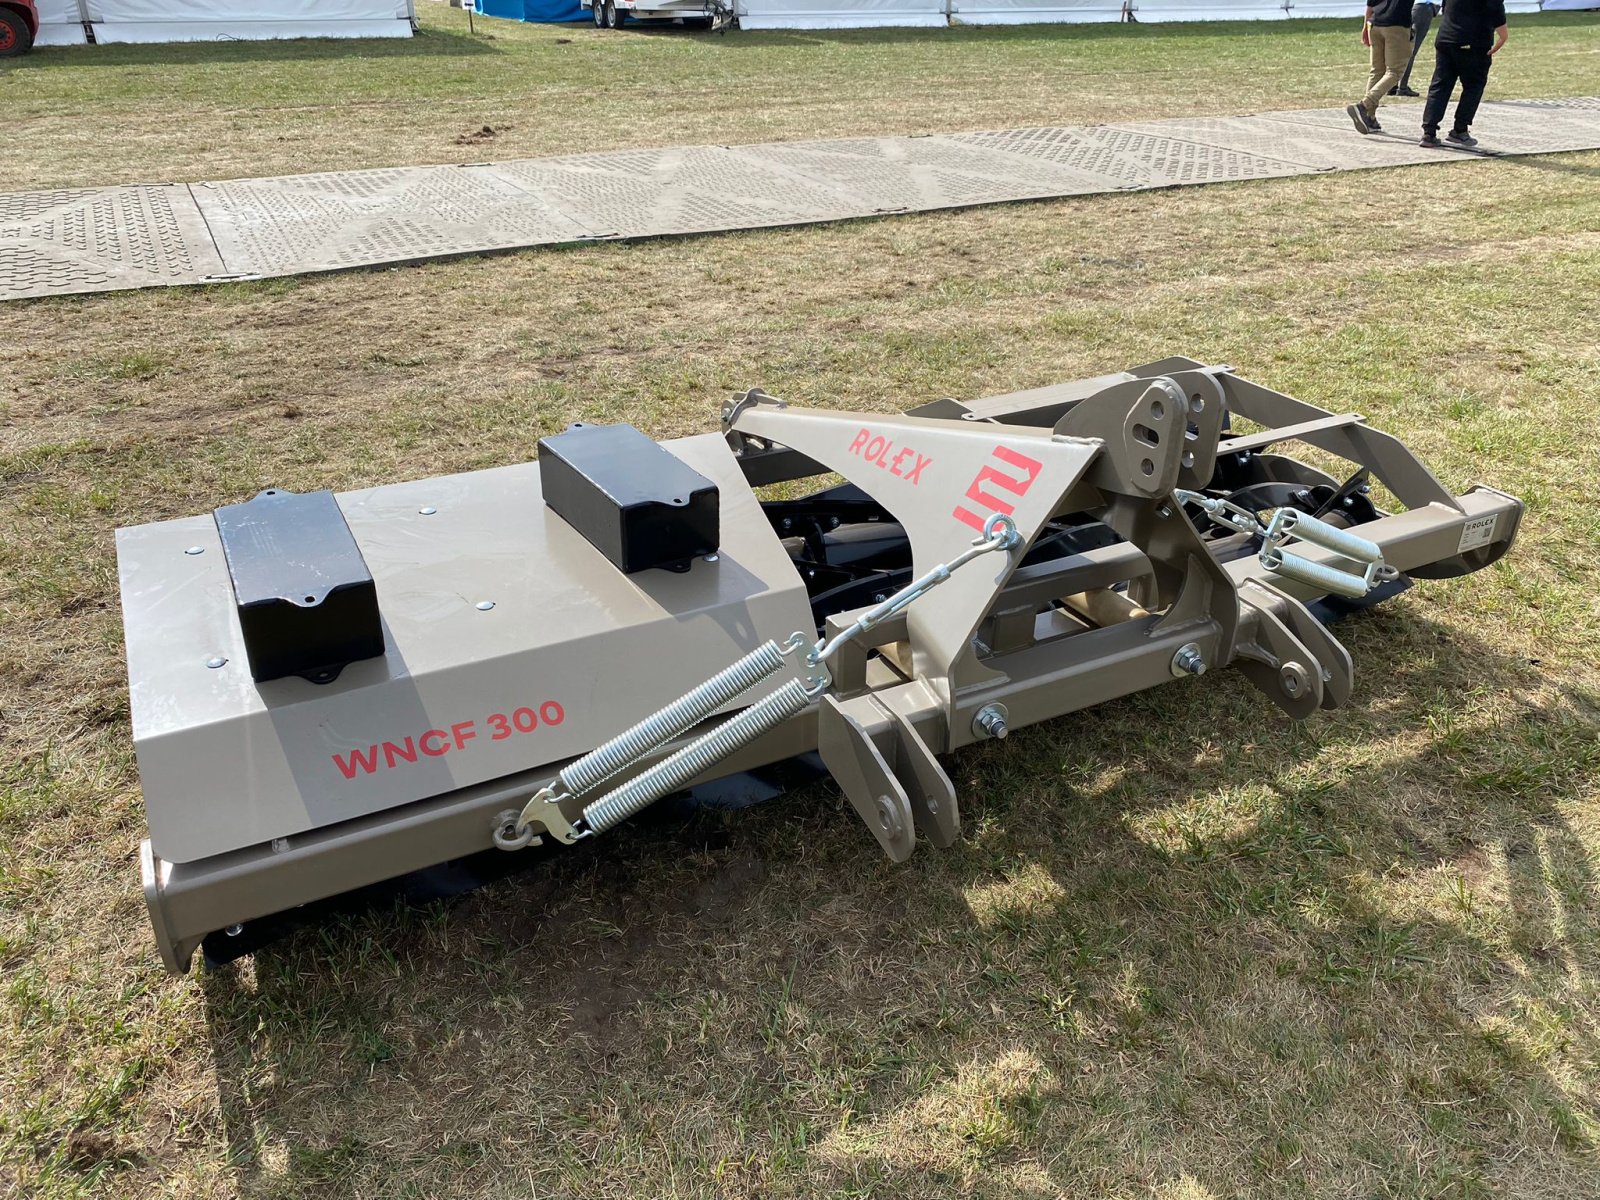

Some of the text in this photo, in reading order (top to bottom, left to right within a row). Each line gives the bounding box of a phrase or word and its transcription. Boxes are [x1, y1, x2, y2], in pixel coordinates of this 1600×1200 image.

[848, 428, 933, 486] ROLEX
[1472, 518, 1494, 529] ROLEX
[331, 700, 565, 780] WNCF 300
